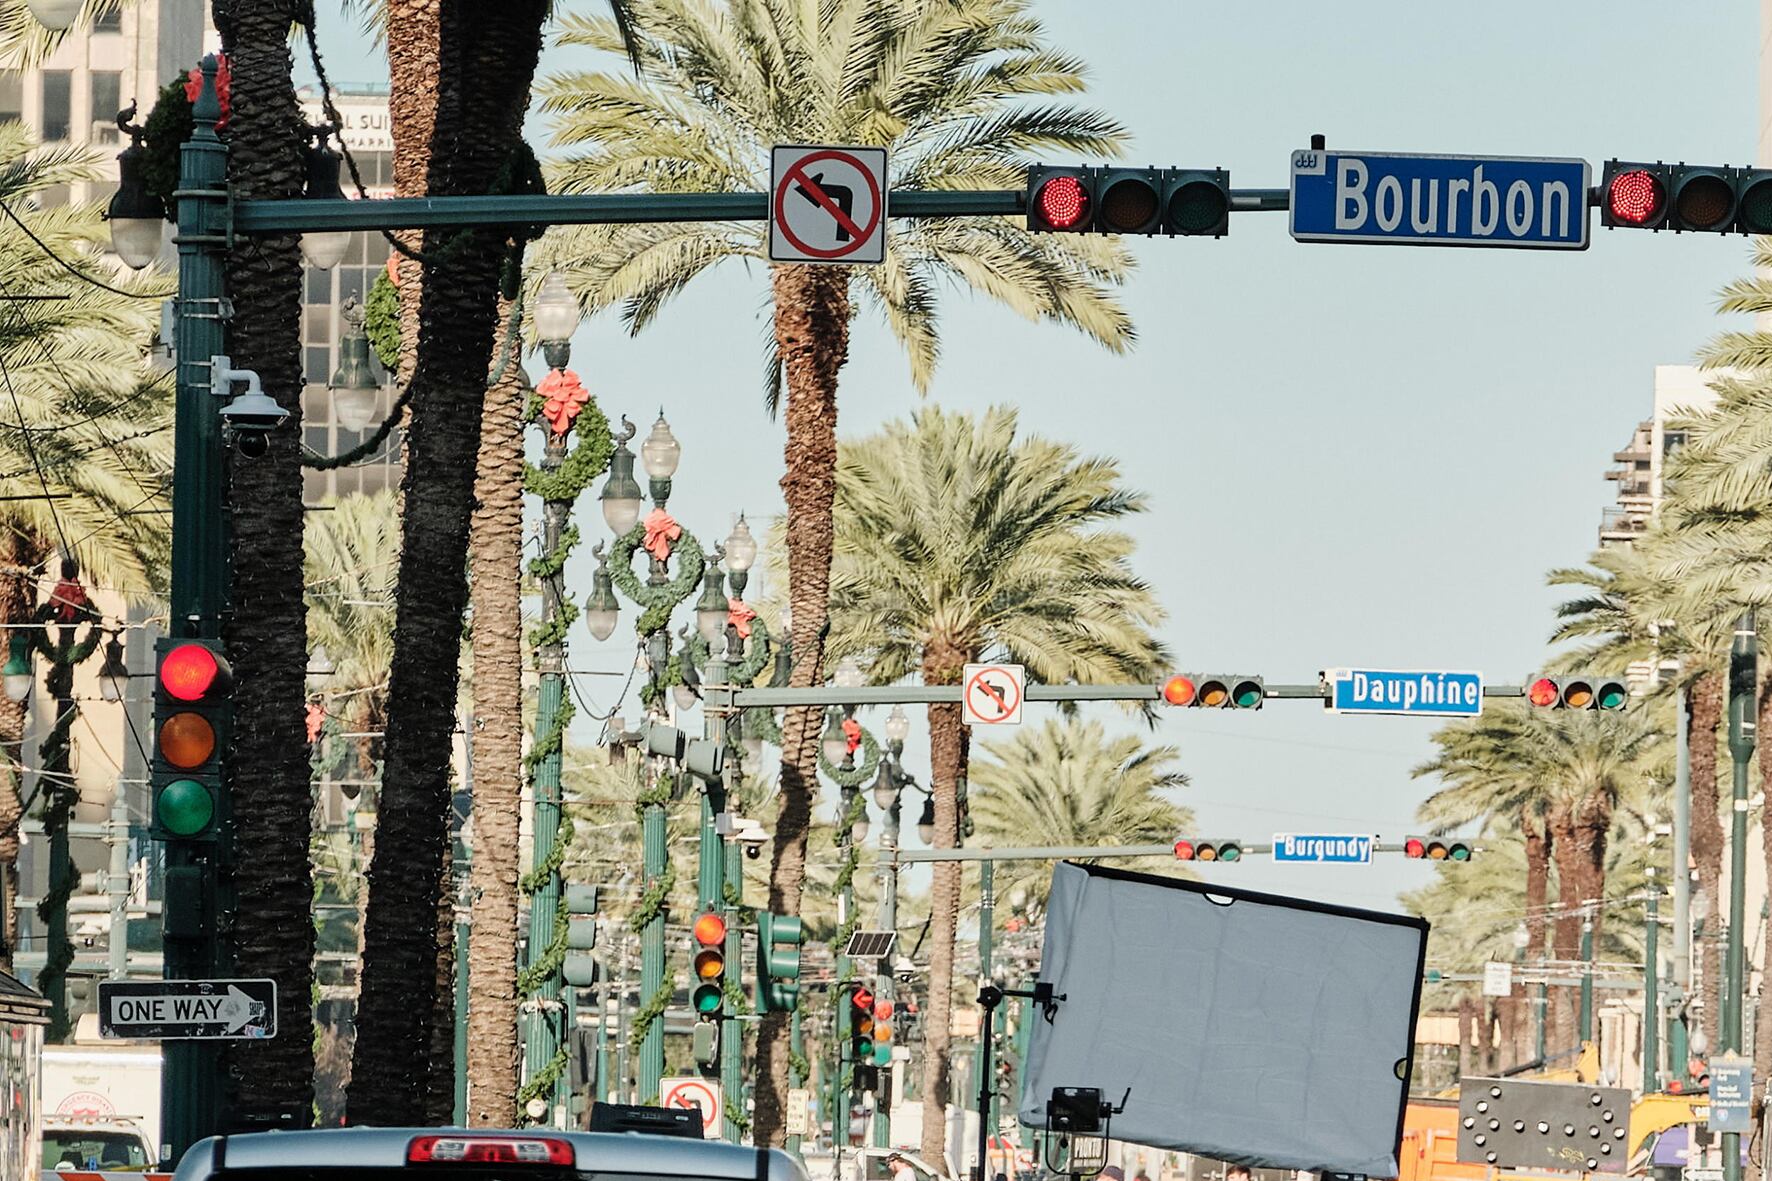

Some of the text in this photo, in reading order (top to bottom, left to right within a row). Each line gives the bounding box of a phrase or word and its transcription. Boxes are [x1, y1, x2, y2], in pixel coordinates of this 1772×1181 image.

[1335, 158, 1570, 237] Bourbon
[1353, 673, 1478, 710] Dauphine
[1284, 835, 1369, 862] Burgundy
[118, 999, 222, 1021] ONE WAY
